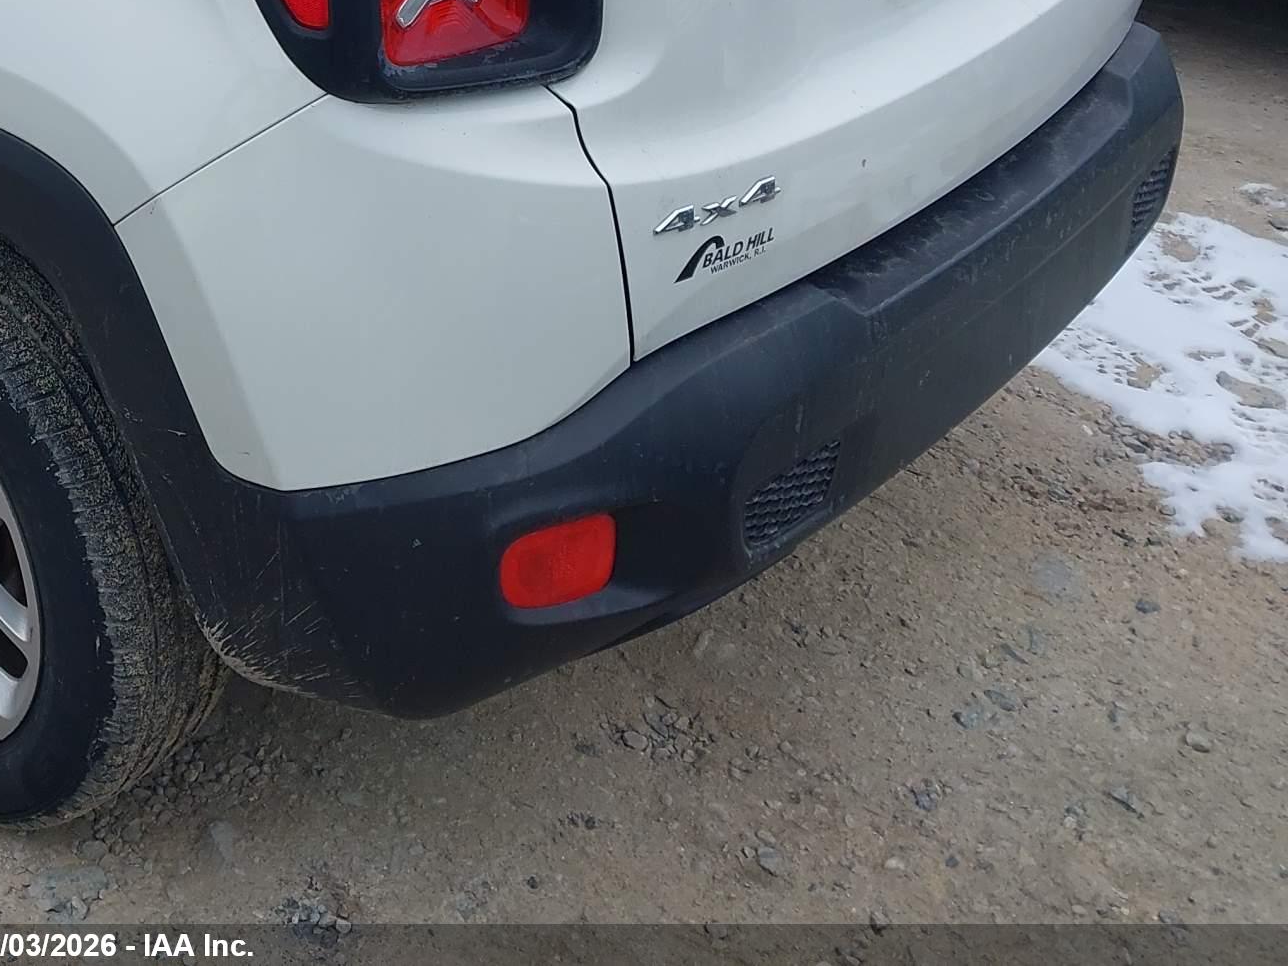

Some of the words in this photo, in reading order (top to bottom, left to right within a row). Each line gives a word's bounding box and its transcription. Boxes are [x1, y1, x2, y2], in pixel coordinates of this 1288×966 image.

[701, 241, 744, 269] BALD
[746, 227, 775, 251] HILL
[710, 252, 752, 274] WARWICK,
